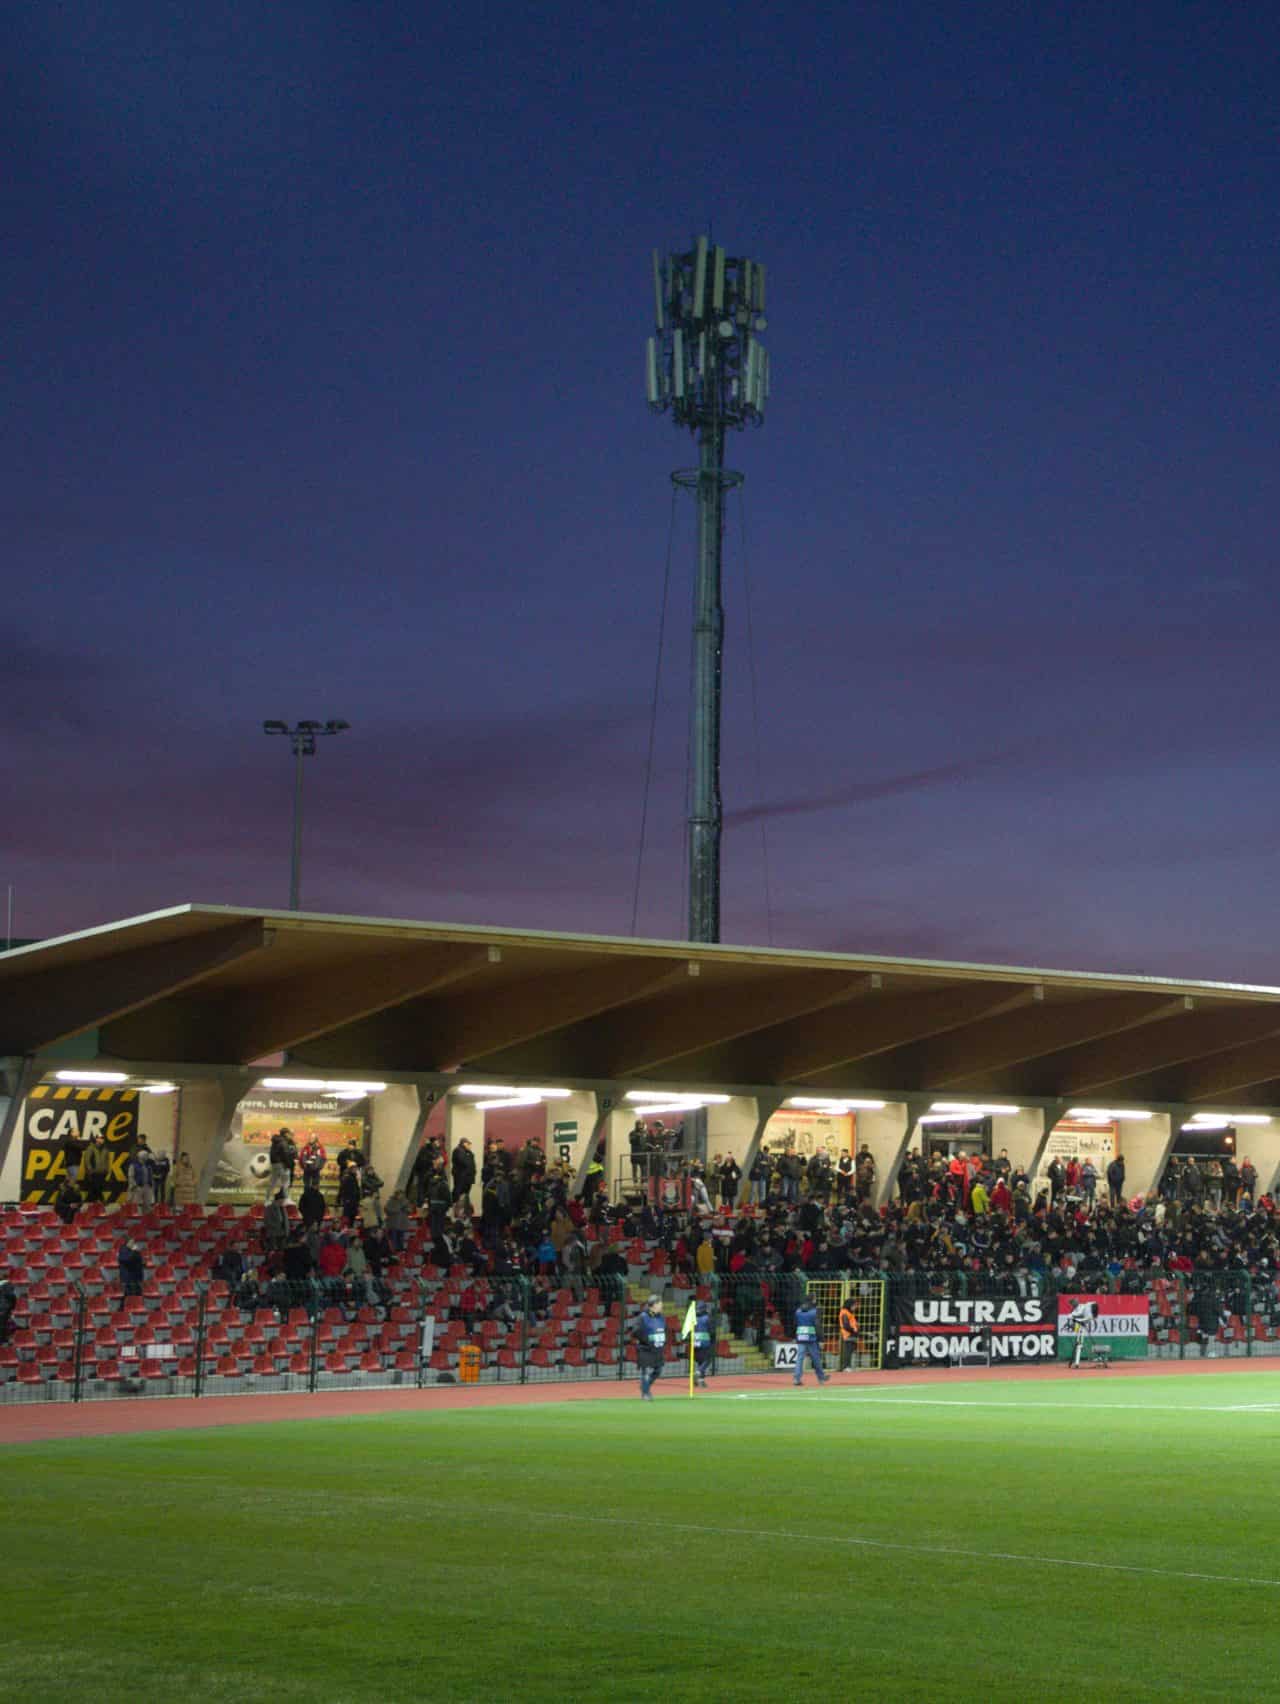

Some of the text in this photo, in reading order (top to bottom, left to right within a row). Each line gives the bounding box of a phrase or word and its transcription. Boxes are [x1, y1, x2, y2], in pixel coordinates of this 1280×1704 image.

[914, 1300, 1043, 1323] ULTRAS
[1063, 1317, 1141, 1333] BDAFOK
[777, 1347, 798, 1365] A2
